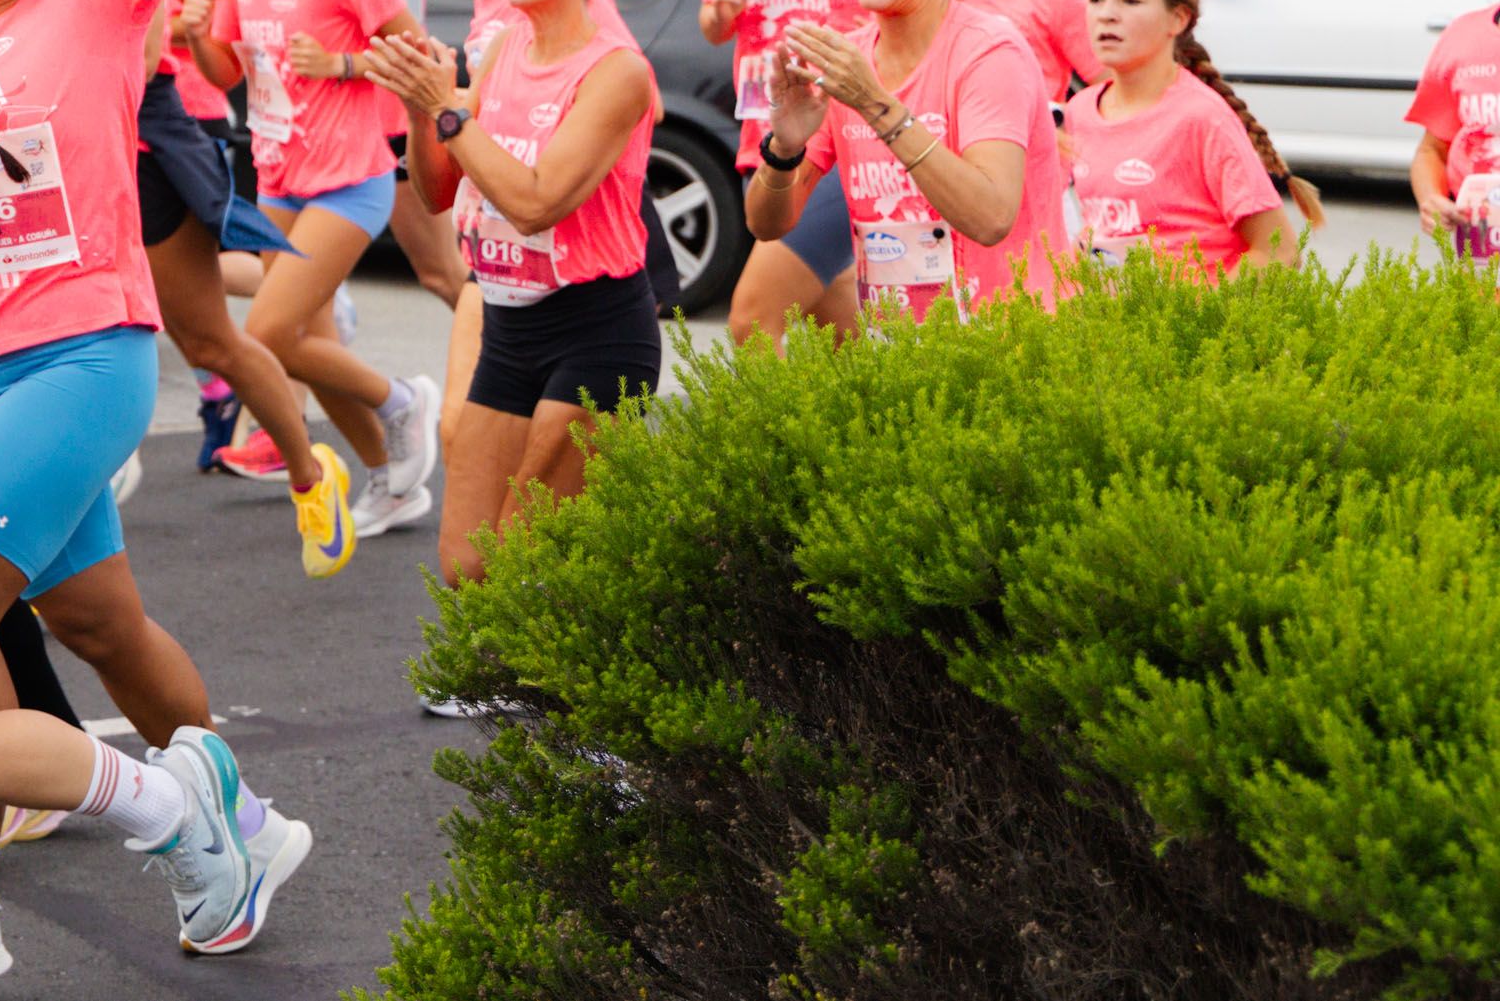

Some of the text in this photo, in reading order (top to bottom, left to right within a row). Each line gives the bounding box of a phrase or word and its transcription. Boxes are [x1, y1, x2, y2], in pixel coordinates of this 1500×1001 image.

[850, 161, 919, 200] CARRE
[19, 235, 26, 243] A
[13, 247, 59, 263] Santander
[481, 239, 524, 265] 016
